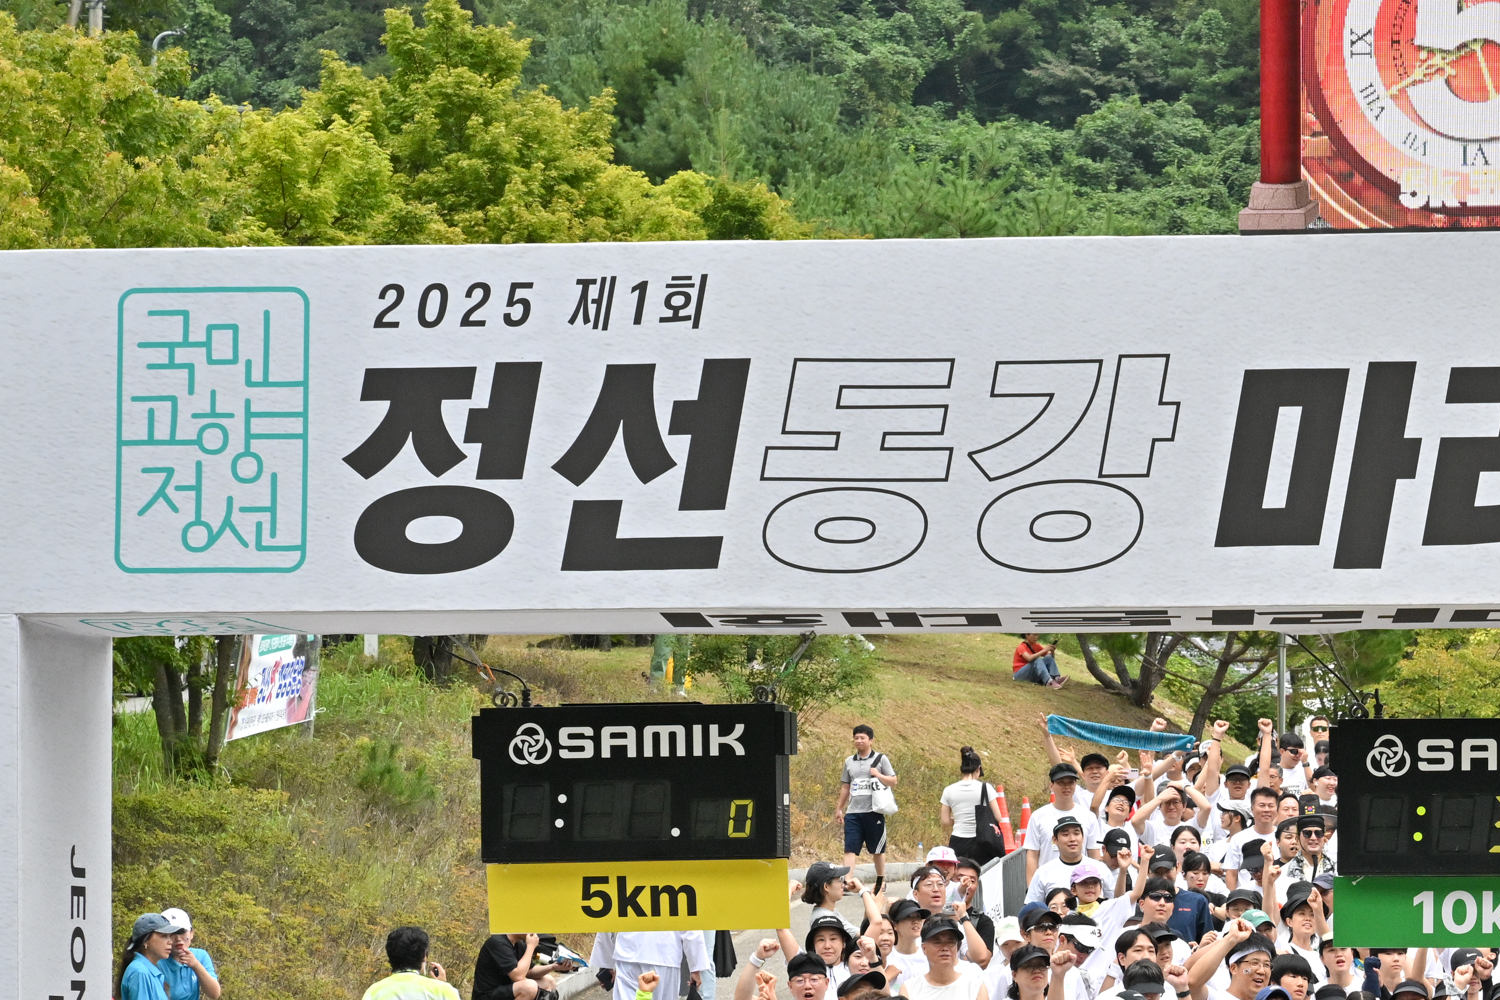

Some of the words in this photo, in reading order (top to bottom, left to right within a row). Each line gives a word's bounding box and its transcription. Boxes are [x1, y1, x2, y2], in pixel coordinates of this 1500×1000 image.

[373, 281, 535, 330] 2025
[568, 274, 709, 331] 제1회
[137, 309, 304, 395] 국민
[121, 389, 303, 484] 고향
[137, 461, 302, 554] 정선
[558, 723, 746, 759] SAMIK
[580, 876, 698, 919] 5km
